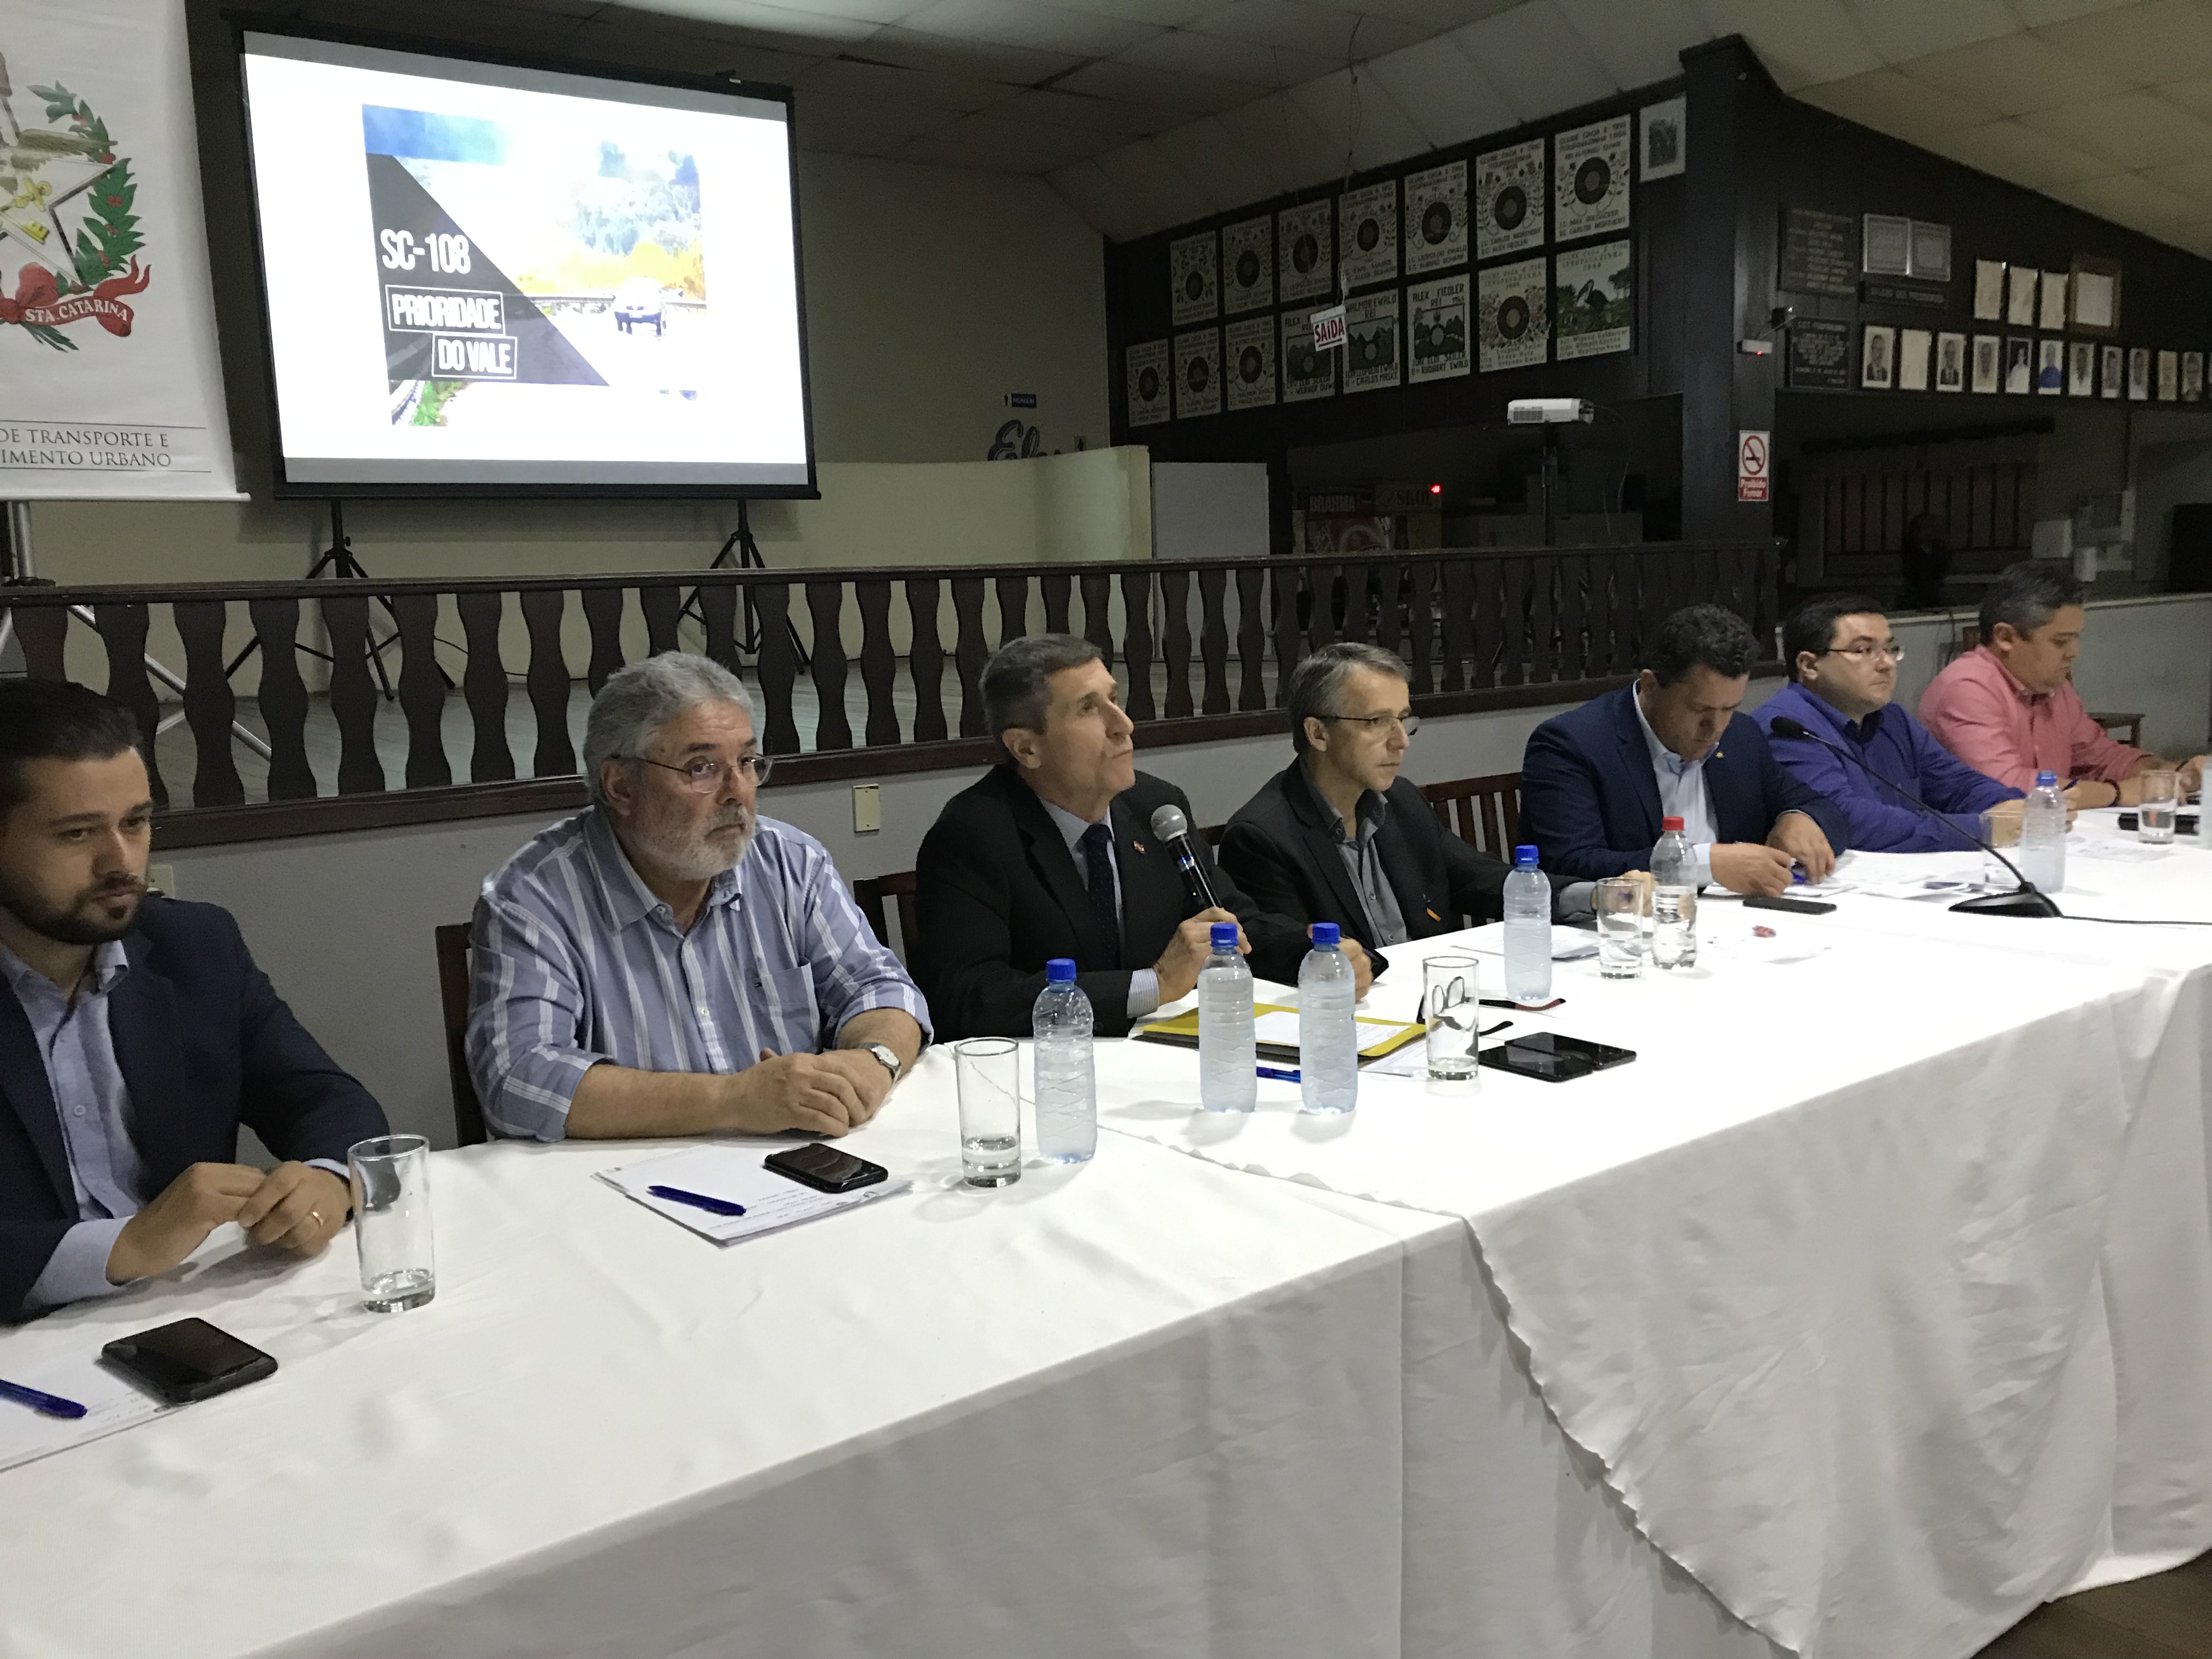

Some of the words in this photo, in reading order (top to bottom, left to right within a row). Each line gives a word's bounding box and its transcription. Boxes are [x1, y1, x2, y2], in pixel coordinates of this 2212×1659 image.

[380, 228, 471, 274] SC-108
[58, 298, 127, 321] CATARINA
[391, 294, 502, 330] PRIORIDADE
[438, 338, 465, 371] DO
[466, 340, 512, 375] VALE
[26, 428, 153, 448] TRANSPORTE
[160, 433, 168, 448] E
[2, 449, 83, 465] IMENTO
[89, 452, 171, 467] URBANO
[1309, 495, 1356, 513] BRAHMA
